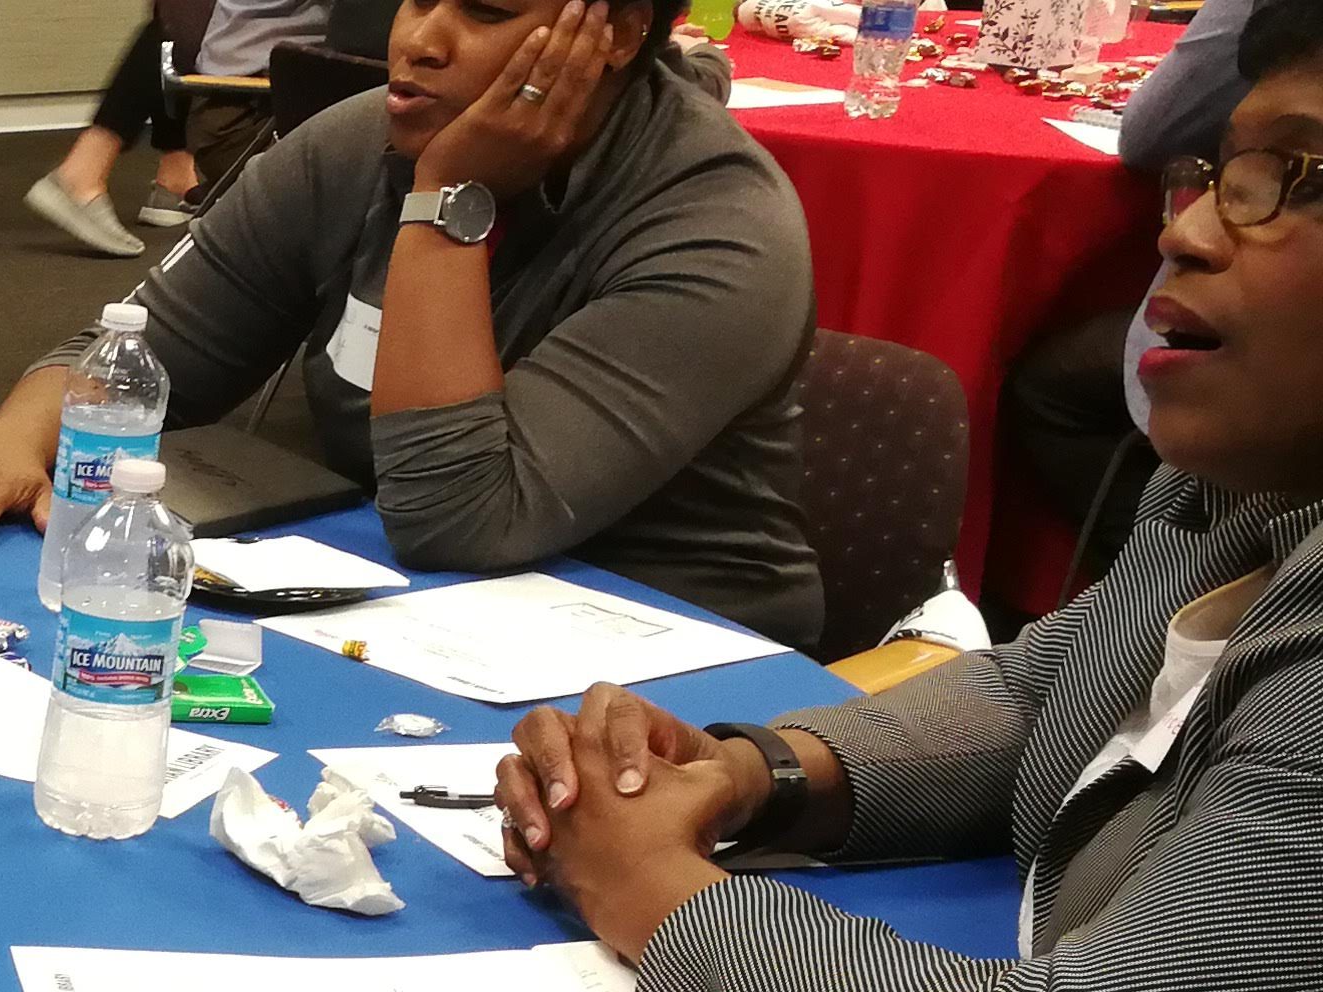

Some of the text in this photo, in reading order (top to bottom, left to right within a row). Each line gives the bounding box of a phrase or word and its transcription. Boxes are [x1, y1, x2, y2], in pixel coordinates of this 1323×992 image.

[77, 463, 94, 477] ICE
[72, 651, 161, 672] ICE MOUNTAIN
[189, 706, 230, 721] Extra
[168, 743, 225, 770] LIBRARY
